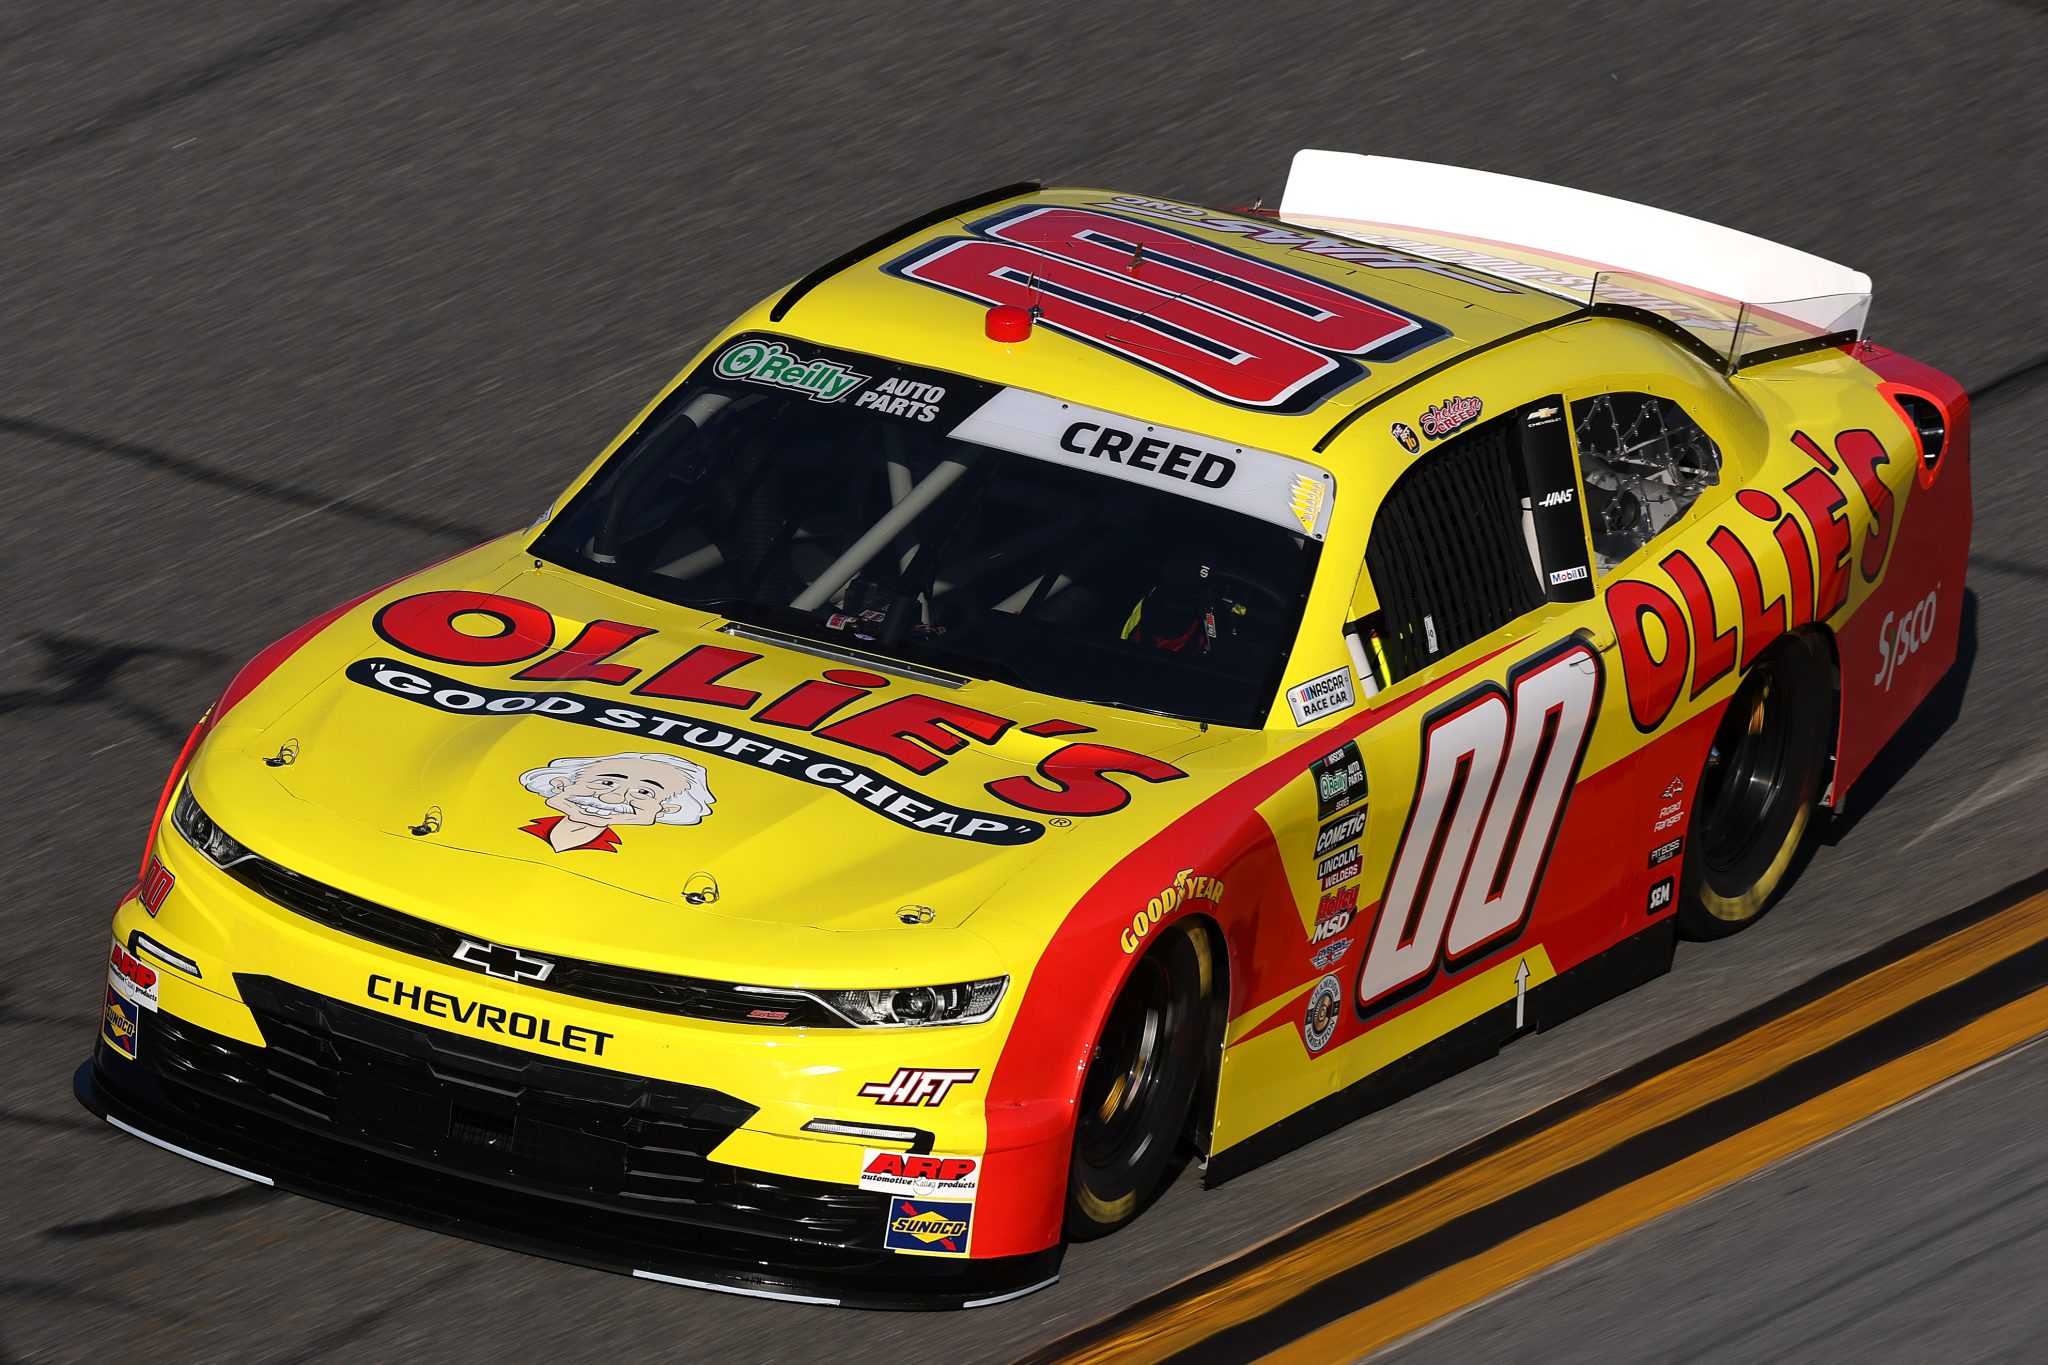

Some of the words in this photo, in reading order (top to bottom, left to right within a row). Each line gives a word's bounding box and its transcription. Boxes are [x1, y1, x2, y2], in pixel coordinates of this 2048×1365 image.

[1093, 203, 1524, 294] HAAS
[895, 206, 1436, 410] 00
[718, 342, 862, 400] O'Reilly
[876, 377, 946, 403] AUTO
[855, 391, 940, 422] PARTS
[1420, 397, 1482, 435] Sheldon
[1437, 408, 1477, 433] CREED
[1528, 417, 1562, 428] CHEVROLET
[1060, 422, 1236, 488] CREED
[1538, 488, 1574, 507] HAAS
[1552, 570, 1577, 583] Mobil
[1308, 675, 1345, 699] NASCAR
[1303, 699, 1328, 717] RACE
[1330, 691, 1347, 706] CAR
[594, 708, 808, 766] STUFF
[1329, 748, 1345, 764] NASCAR
[1348, 761, 1360, 775] AUTO
[1348, 771, 1363, 787] PARTS
[1336, 797, 1350, 811] SERIES
[1659, 800, 1682, 818] Road
[1317, 813, 1365, 851] COMETIC
[1356, 640, 1603, 1012] 00
[1653, 812, 1684, 832] Ranger
[1319, 847, 1357, 877] LINCOLN
[141, 855, 175, 919] 00
[1325, 864, 1358, 888] WELDERS
[1315, 884, 1360, 925] Holley
[1650, 882, 1670, 909] SEM
[1312, 911, 1350, 945] MSD
[111, 943, 156, 990] ARP
[107, 1006, 134, 1036] SUNOCO
[367, 974, 614, 1056] CHEVROLET
[857, 1067, 980, 1107] HFT
[863, 1153, 976, 1180] ARP
[861, 1174, 912, 1185] automotive
[938, 1181, 975, 1189] products
[895, 1219, 964, 1235] SUNOCO
